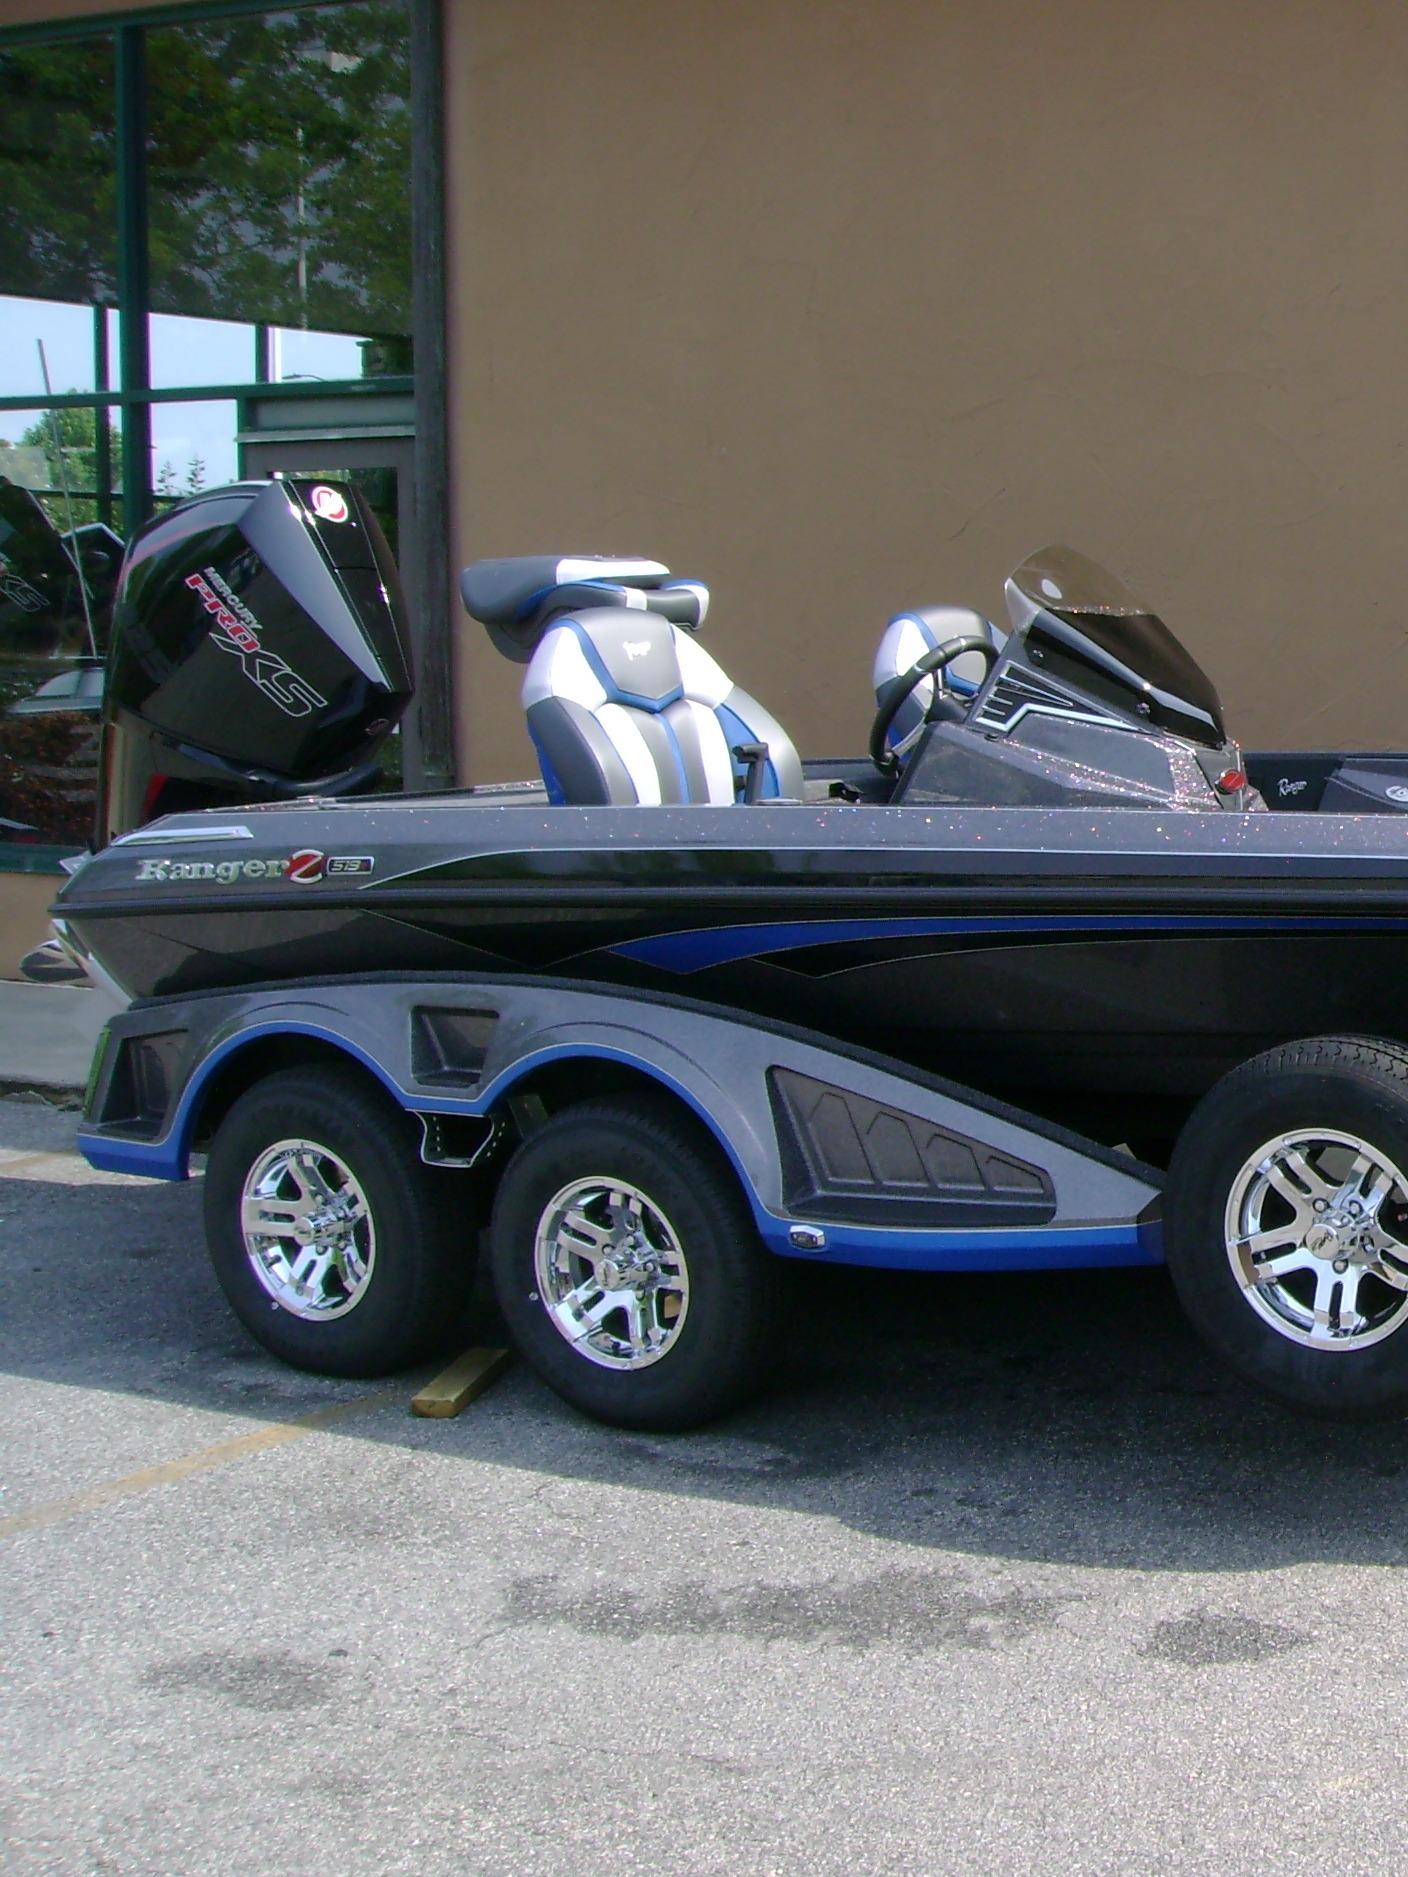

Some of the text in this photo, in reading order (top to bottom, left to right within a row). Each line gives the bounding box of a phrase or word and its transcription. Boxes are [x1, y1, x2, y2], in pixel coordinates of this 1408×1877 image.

[204, 566, 263, 630] MERCURY
[185, 573, 328, 717] PRO XS
[135, 857, 290, 885] Ranger
